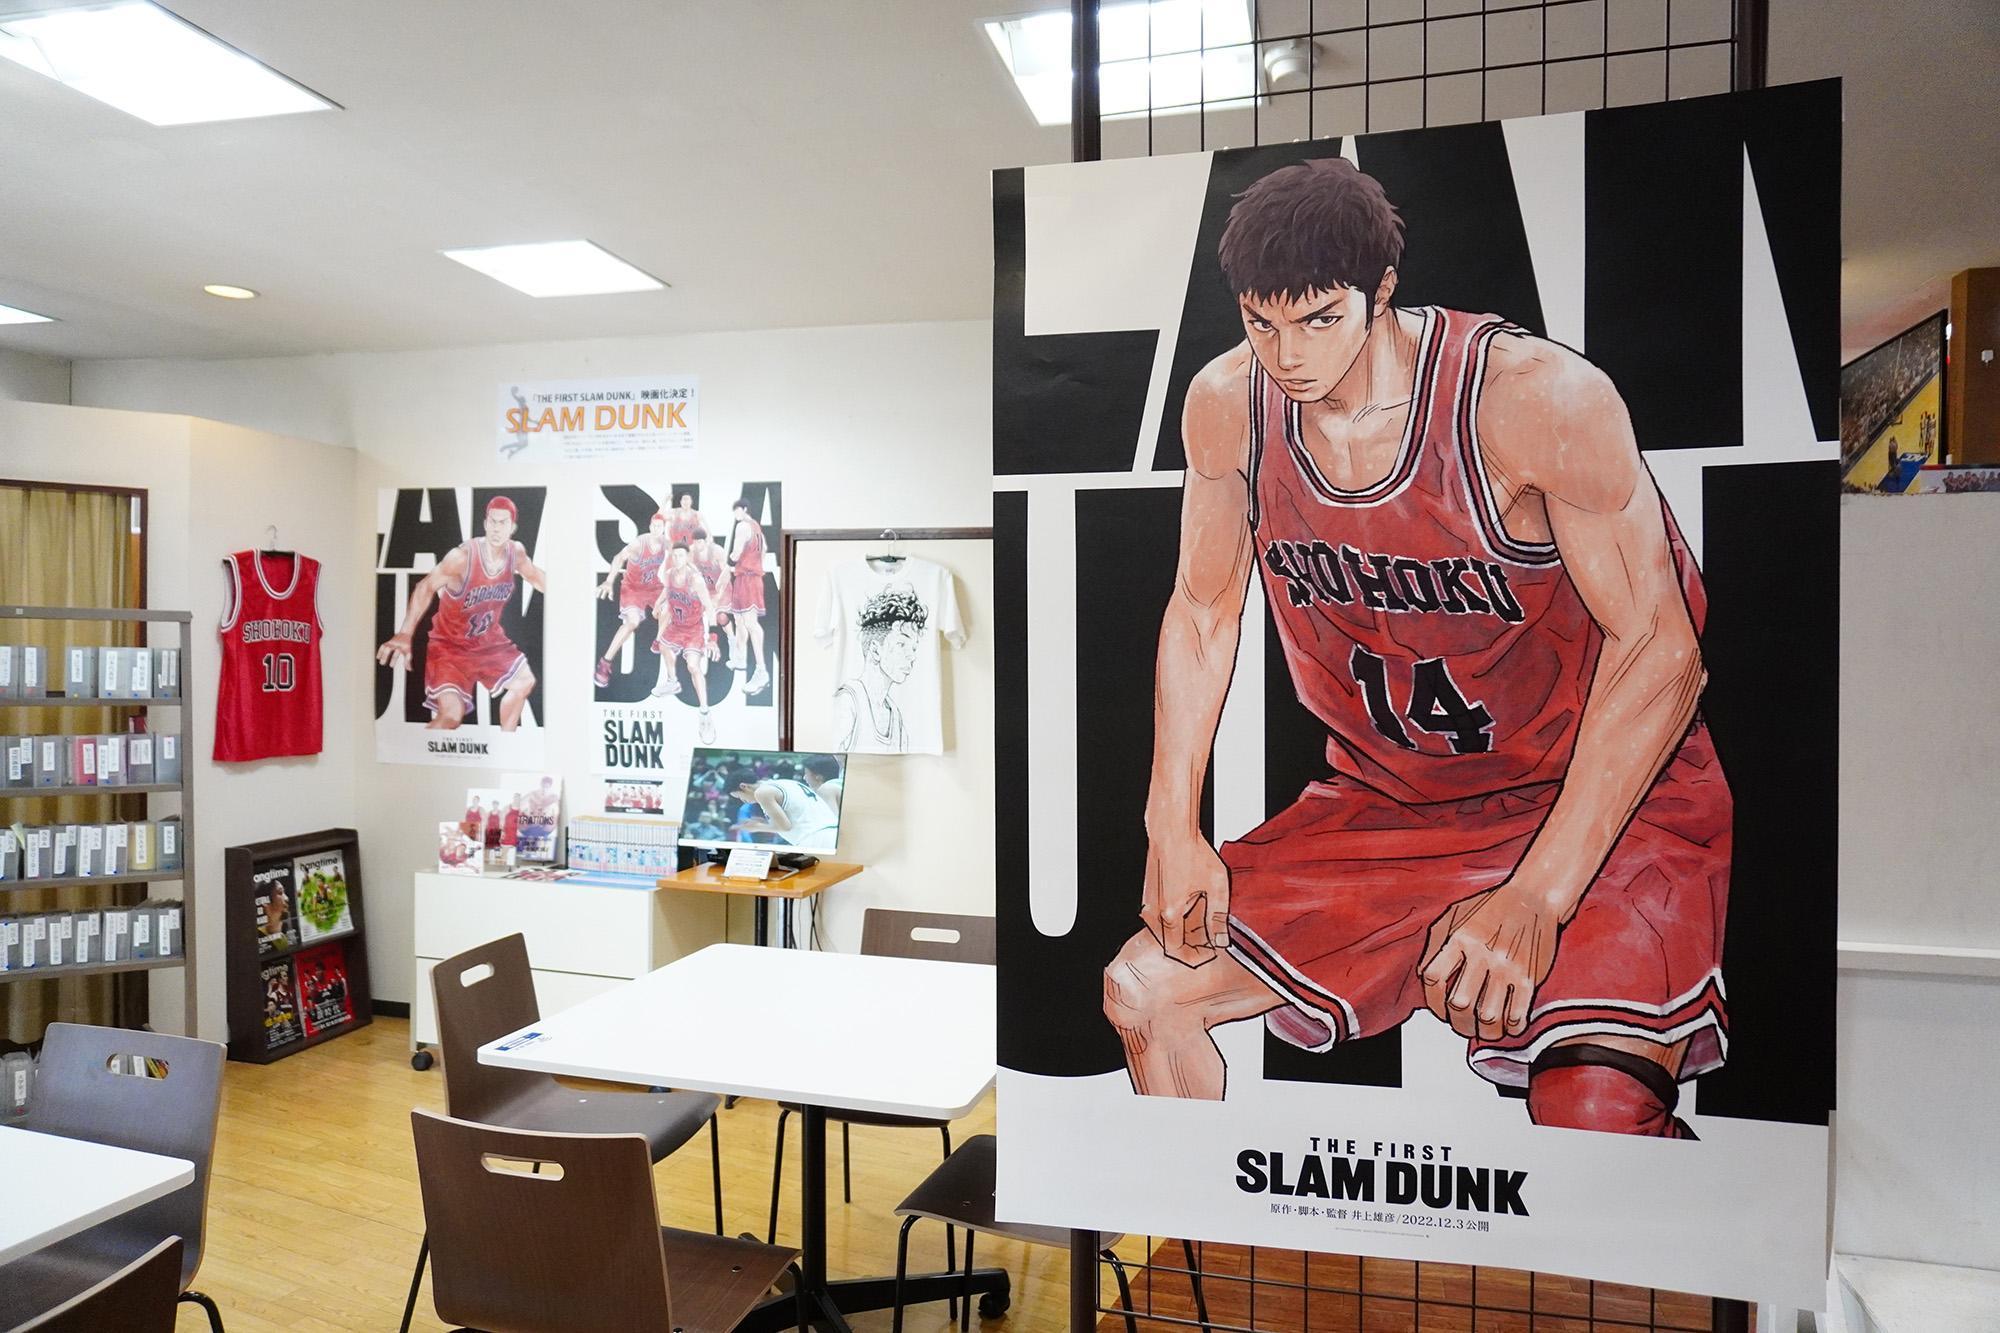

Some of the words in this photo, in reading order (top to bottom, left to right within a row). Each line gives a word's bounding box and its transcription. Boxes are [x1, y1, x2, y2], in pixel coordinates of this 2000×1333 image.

[555, 393, 577, 403] FIRST
[580, 392, 604, 402] SLAM
[505, 406, 585, 433] SLAM
[594, 402, 687, 431] DUNK
[1264, 539, 1526, 625] SHOHOKU
[242, 619, 311, 644] SHOHOKU
[262, 653, 295, 692] 10
[1350, 643, 1496, 755] 14
[603, 709, 622, 718] THE
[630, 710, 663, 719] FIRST
[604, 720, 664, 745] SLAM
[427, 741, 457, 753] SLAM
[460, 743, 488, 754] DUNK
[605, 744, 664, 769] DUNK
[1310, 1137, 1355, 1155] THE
[1374, 1141, 1451, 1162] FIRST
[1236, 1149, 1375, 1202] SLAM
[1386, 1161, 1530, 1217] DUNK
